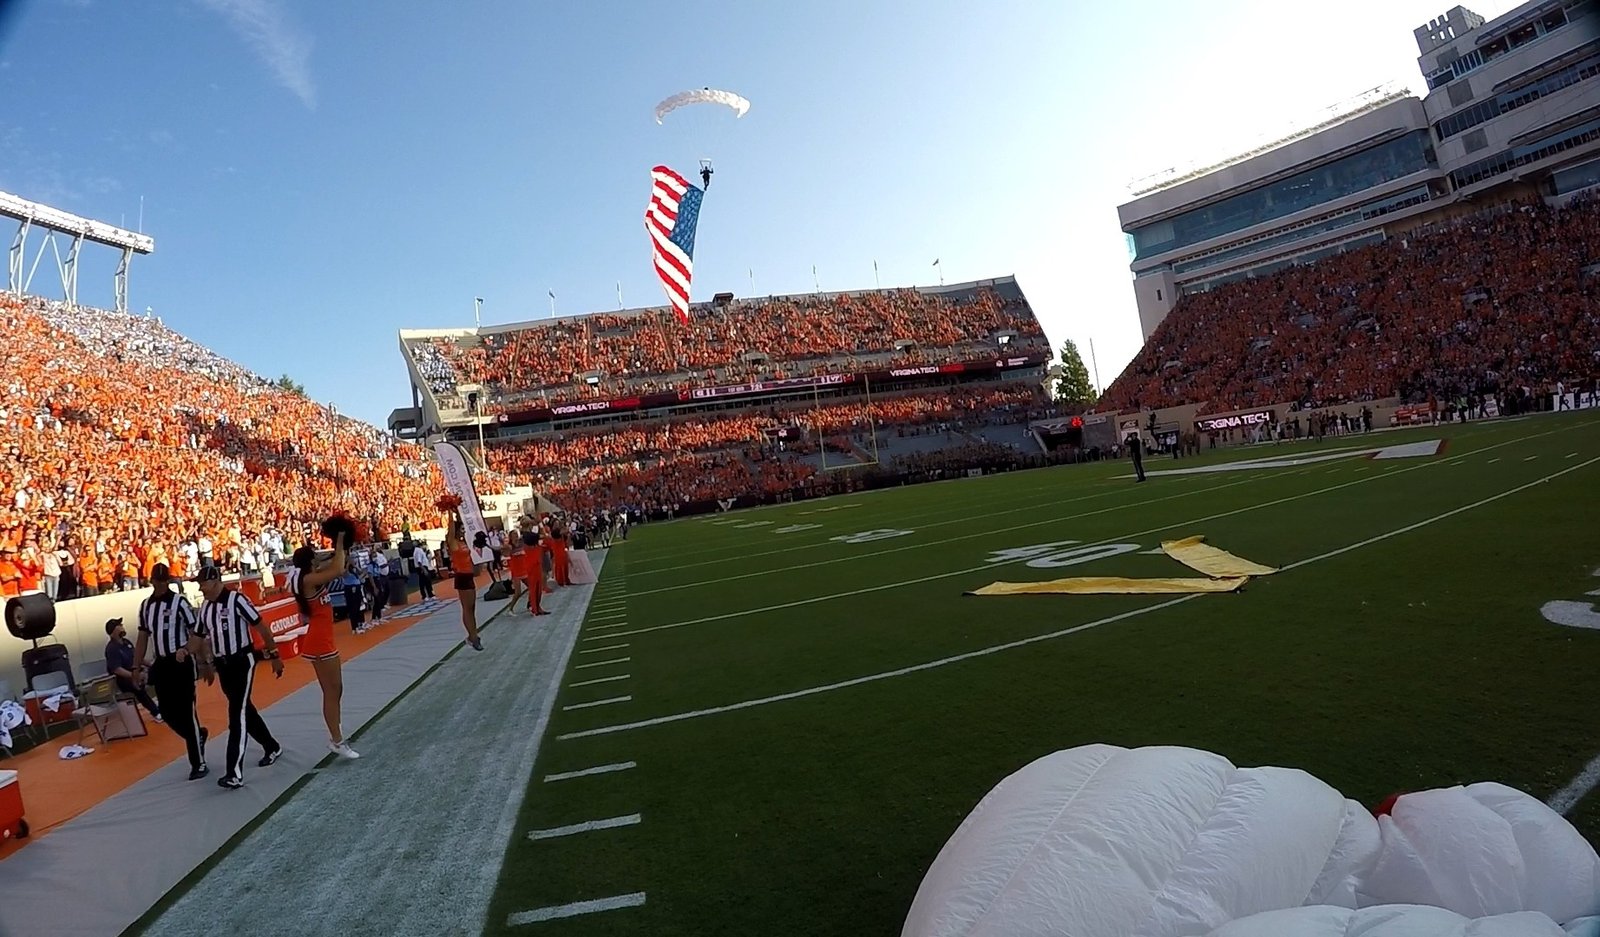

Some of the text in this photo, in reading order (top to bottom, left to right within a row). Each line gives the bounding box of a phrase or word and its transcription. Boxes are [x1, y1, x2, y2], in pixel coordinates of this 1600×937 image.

[890, 367, 921, 377] VIRGINIA
[920, 366, 940, 375] TECH
[551, 404, 588, 415] VIRGINIA
[587, 401, 610, 412] TECH
[1241, 412, 1270, 425] TECH
